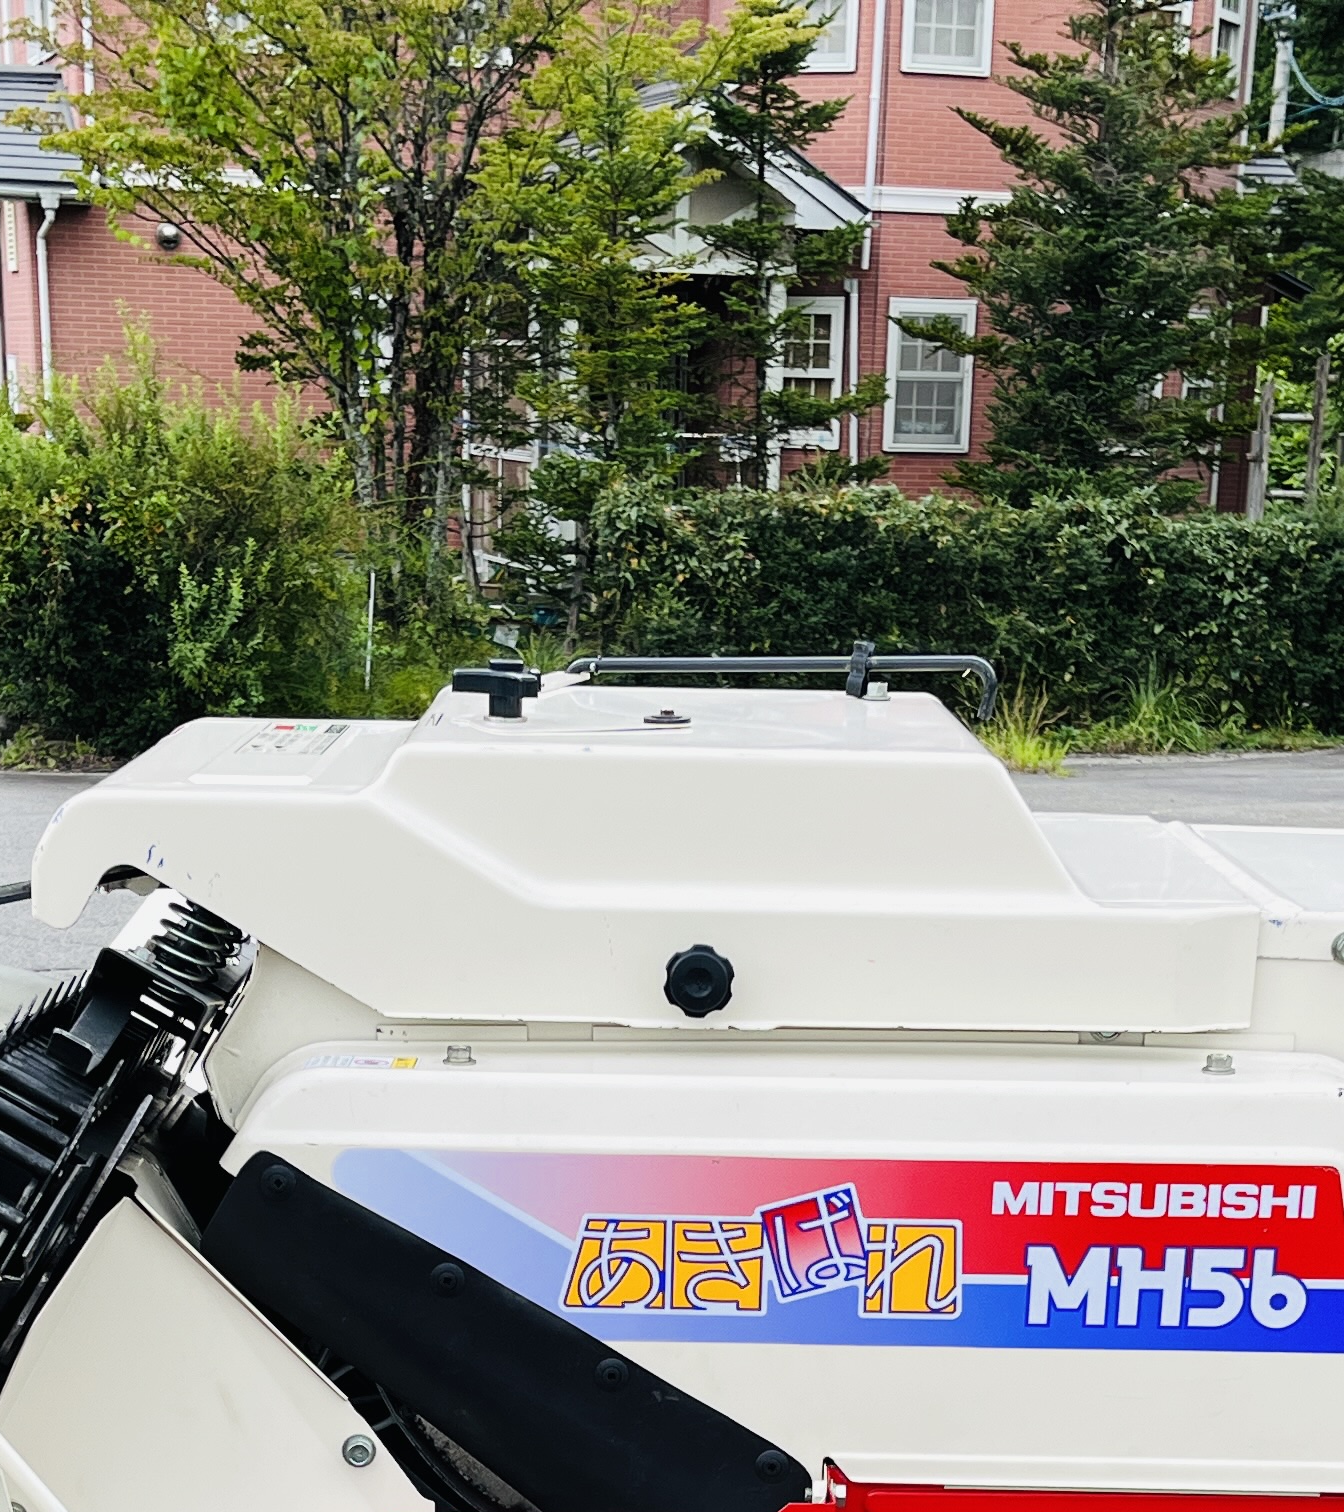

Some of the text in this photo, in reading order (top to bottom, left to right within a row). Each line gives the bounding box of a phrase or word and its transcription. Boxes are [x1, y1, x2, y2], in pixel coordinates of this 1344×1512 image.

[991, 1181, 1317, 1220] MITSUBISHI
[566, 1184, 962, 1316] あきばれ
[1025, 1243, 1308, 1330] MH56
